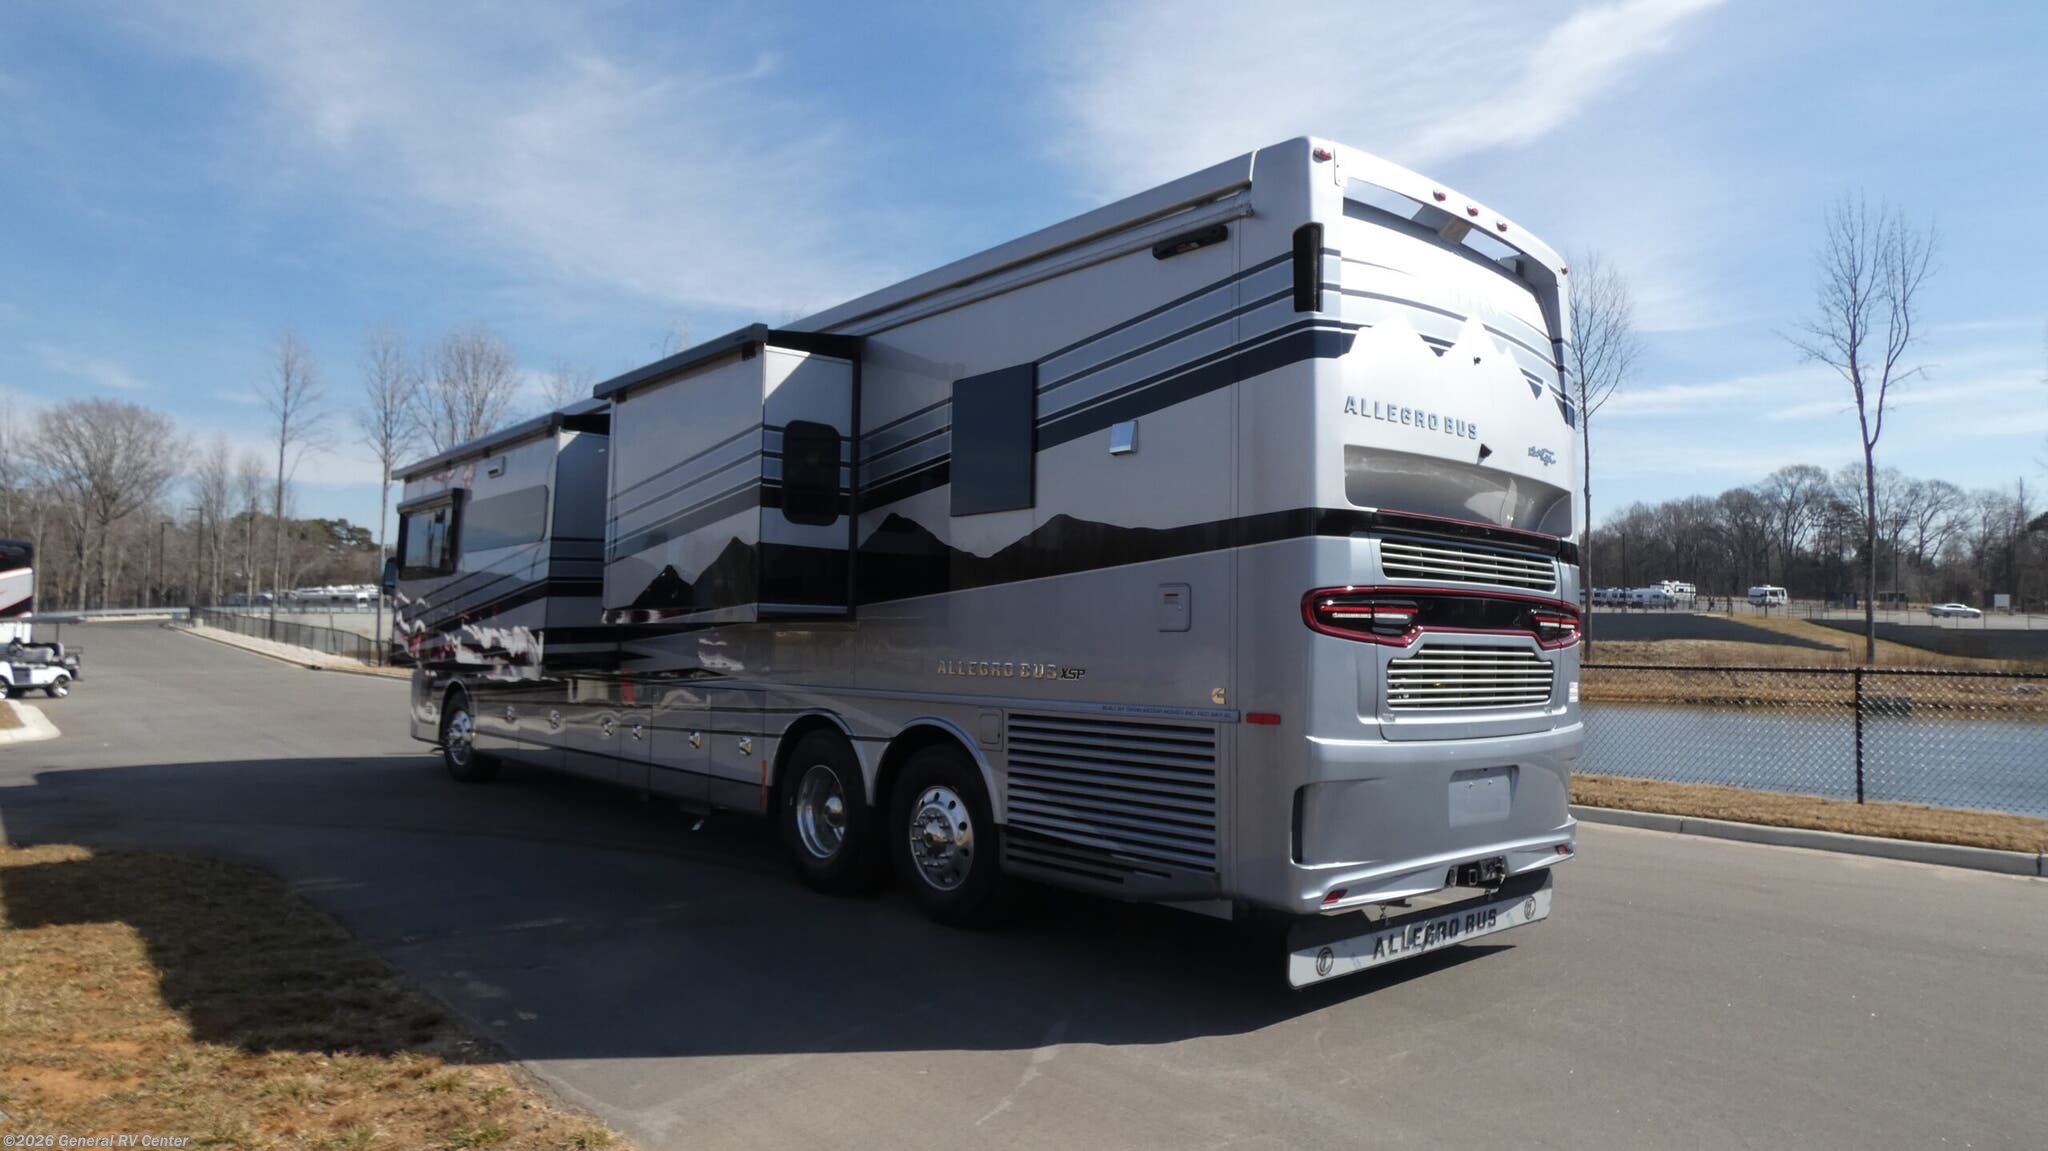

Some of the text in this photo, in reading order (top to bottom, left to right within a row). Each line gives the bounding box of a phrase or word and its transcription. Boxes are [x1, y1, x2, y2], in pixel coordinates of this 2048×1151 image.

[1344, 395, 1477, 440] ALLEGRO BUS
[937, 660, 1086, 681] ALLEGRO BUS XSP
[1373, 909, 1497, 960] ALLEGRO BUS
